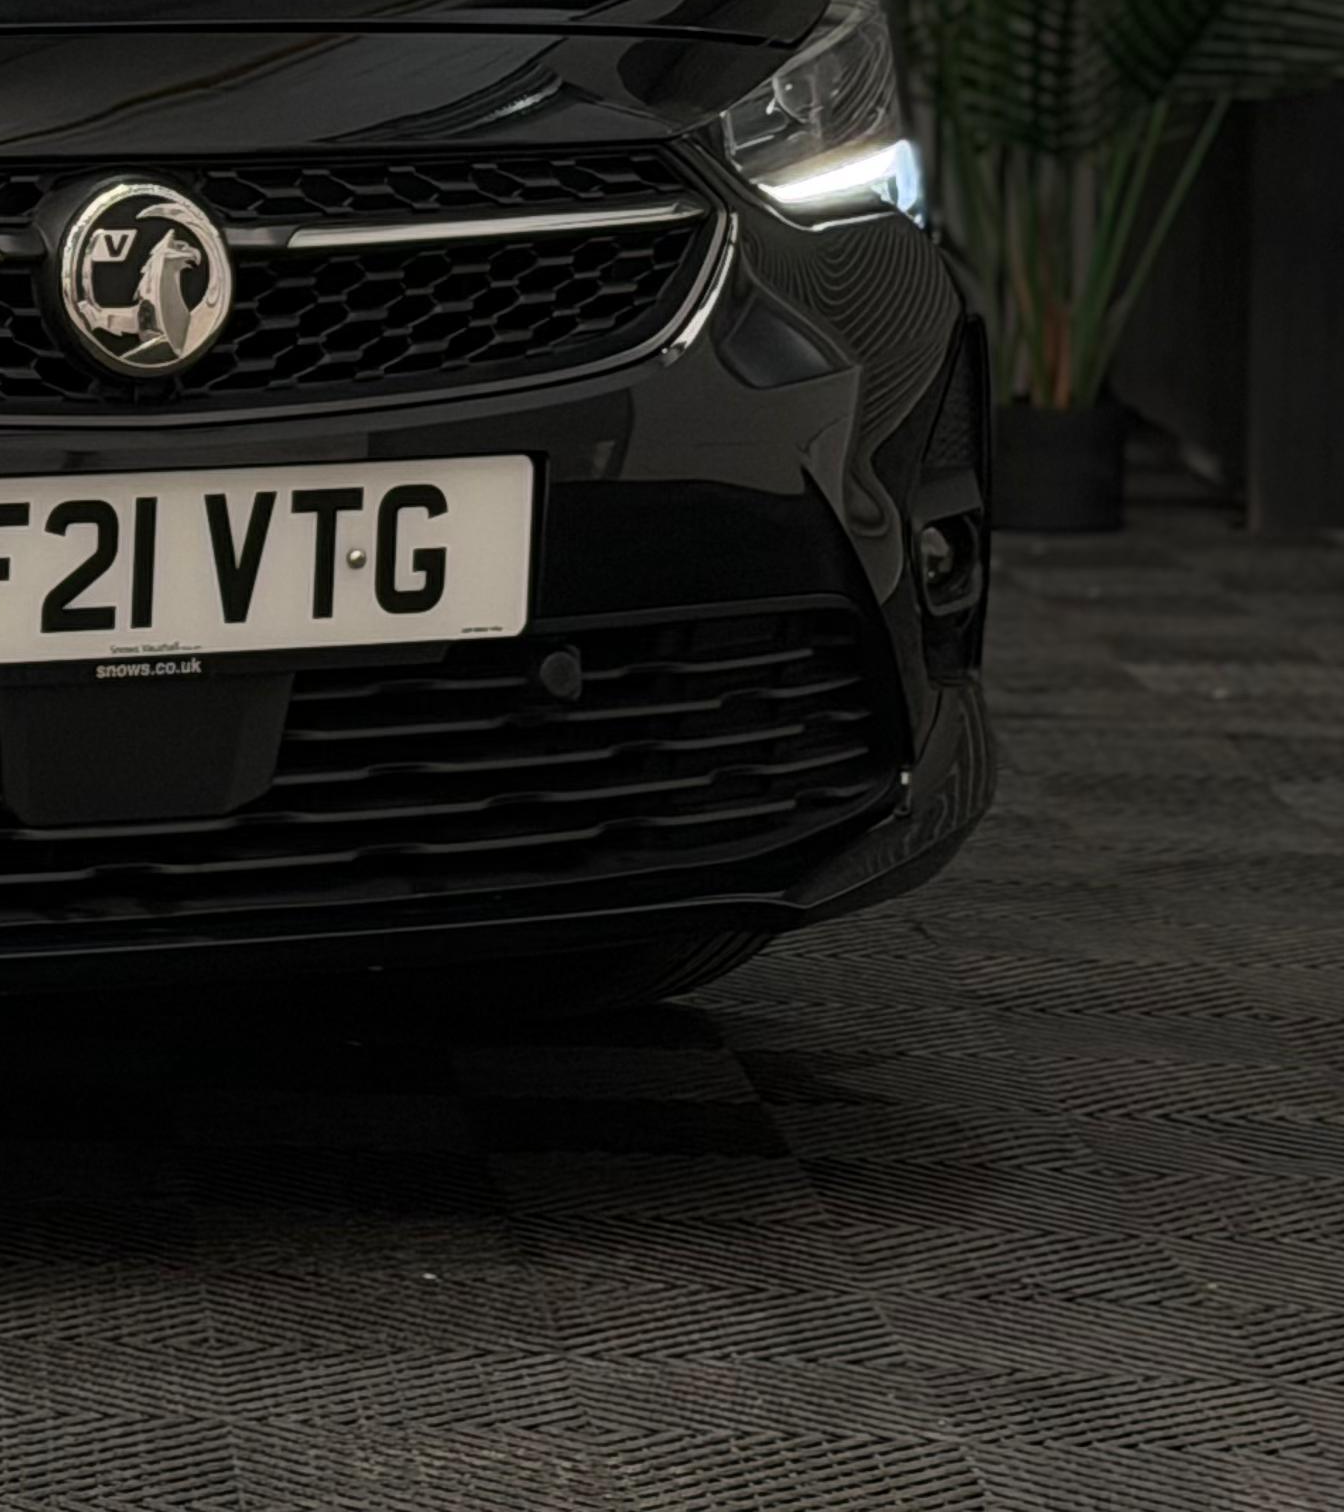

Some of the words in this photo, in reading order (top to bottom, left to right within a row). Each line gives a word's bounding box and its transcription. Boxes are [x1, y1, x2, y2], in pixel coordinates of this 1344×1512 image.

[104, 234, 129, 258] V
[204, 484, 448, 624] VTG
[96, 657, 202, 679] snows.co.uk
